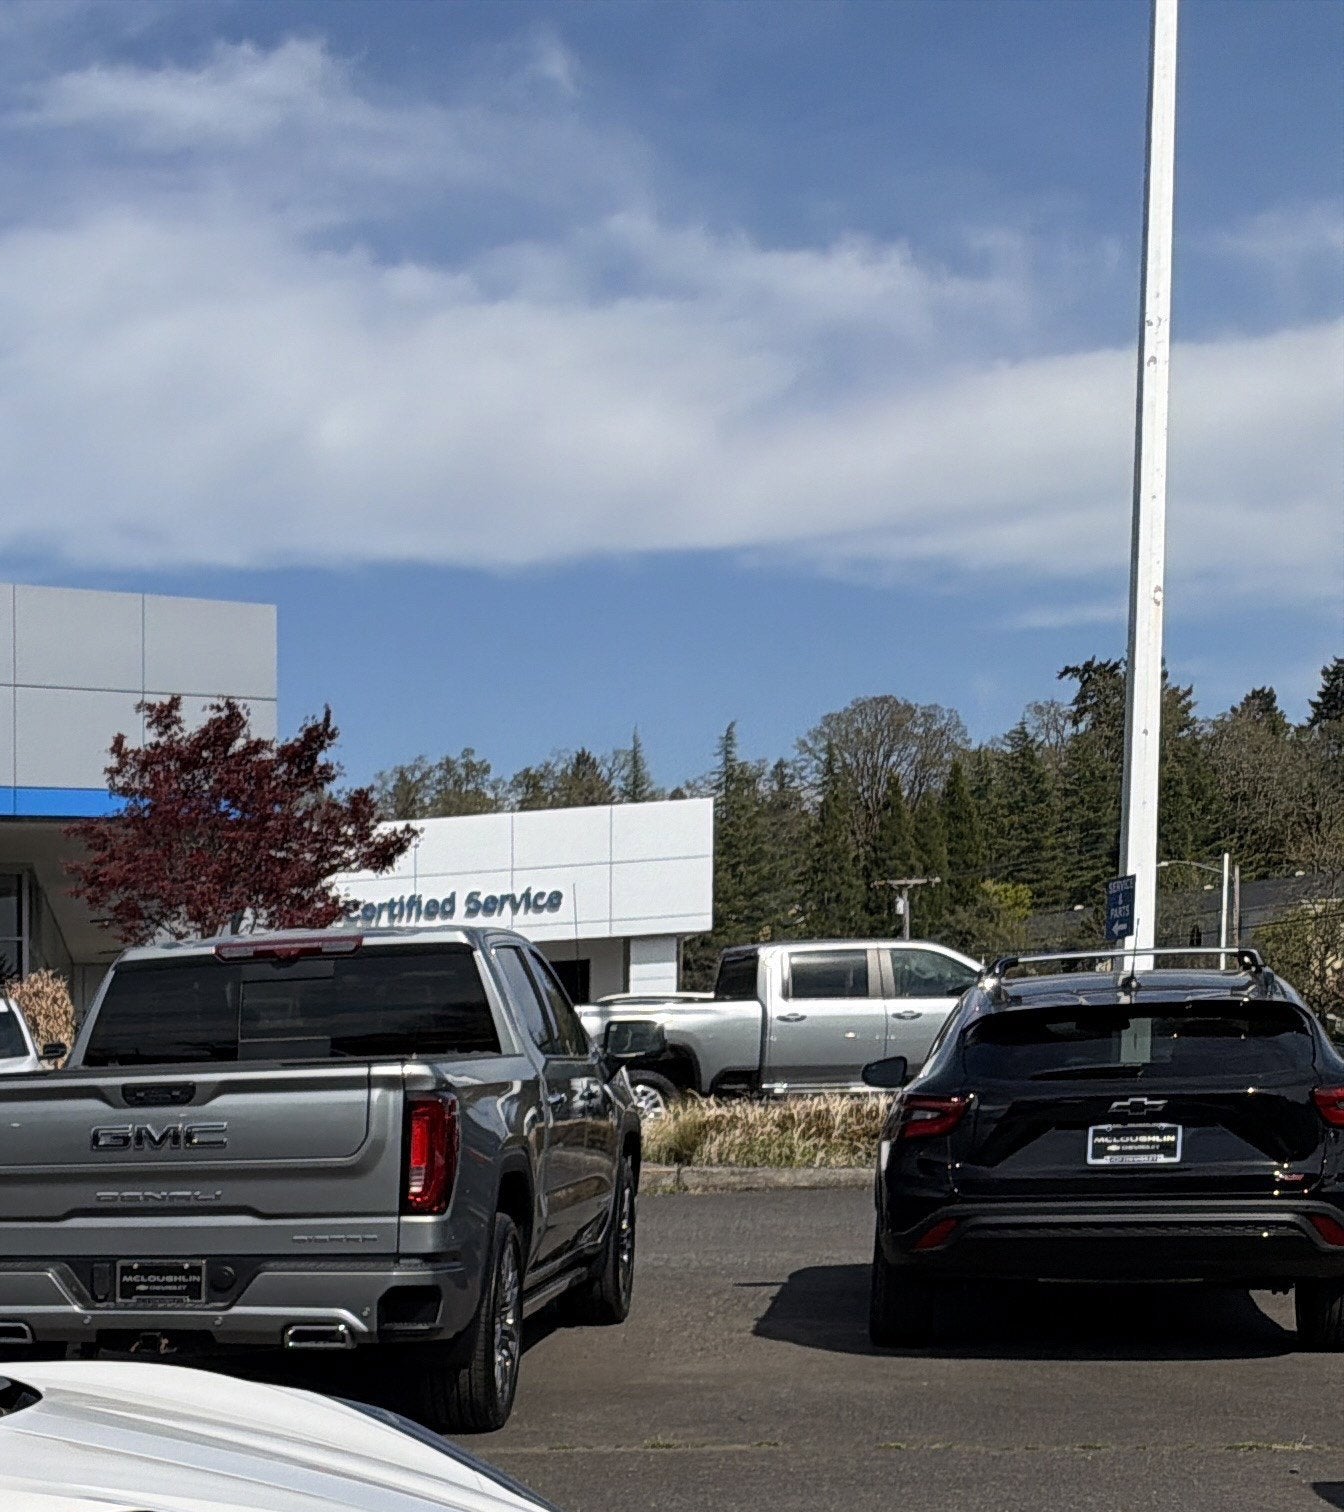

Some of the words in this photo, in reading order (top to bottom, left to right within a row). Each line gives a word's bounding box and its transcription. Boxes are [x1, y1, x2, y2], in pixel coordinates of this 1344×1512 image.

[465, 887, 563, 918] Service
[91, 1122, 228, 1150] GMC
[122, 1274, 201, 1283] MCLOUGHLIN
